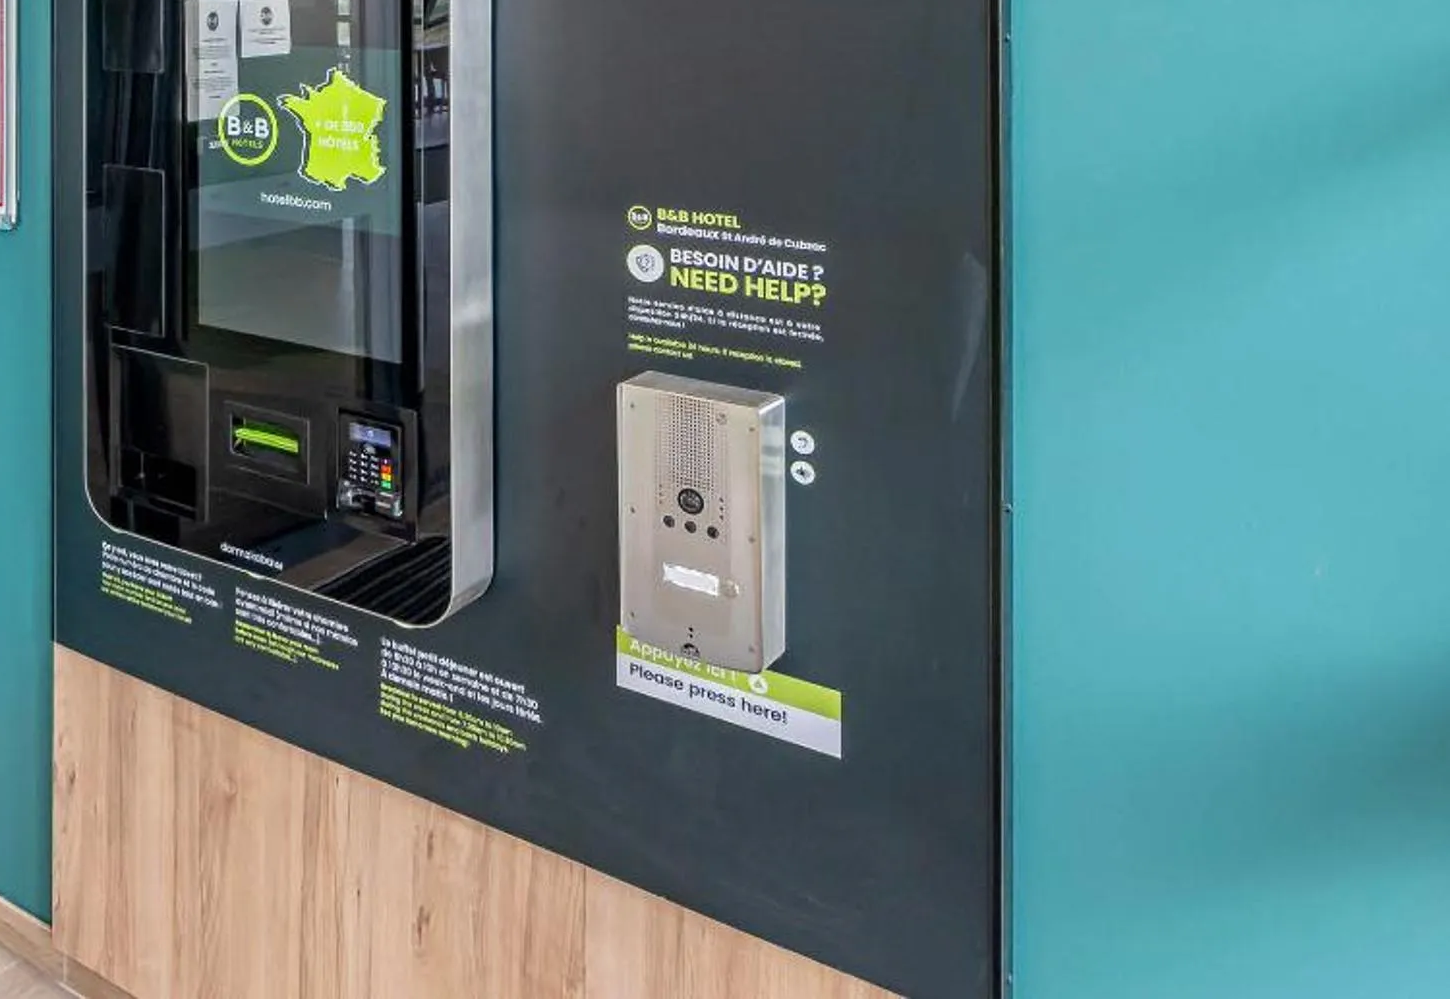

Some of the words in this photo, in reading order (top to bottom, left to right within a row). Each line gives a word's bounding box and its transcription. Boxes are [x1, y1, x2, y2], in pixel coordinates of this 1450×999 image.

[227, 116, 270, 138] B&B
[260, 192, 332, 212] hotelbb.com
[657, 208, 689, 223] B&B
[692, 212, 741, 229] HOTEL
[657, 222, 719, 240] Bordeaux
[734, 232, 766, 246] André
[768, 236, 782, 248] de
[670, 248, 740, 272] BESOIN
[743, 257, 809, 281] D'AIDE
[812, 265, 825, 281] ?
[669, 266, 738, 295] NEED
[745, 275, 827, 307] HELP?
[630, 662, 684, 690] Please
[689, 683, 736, 707] press
[741, 697, 788, 725] here!
